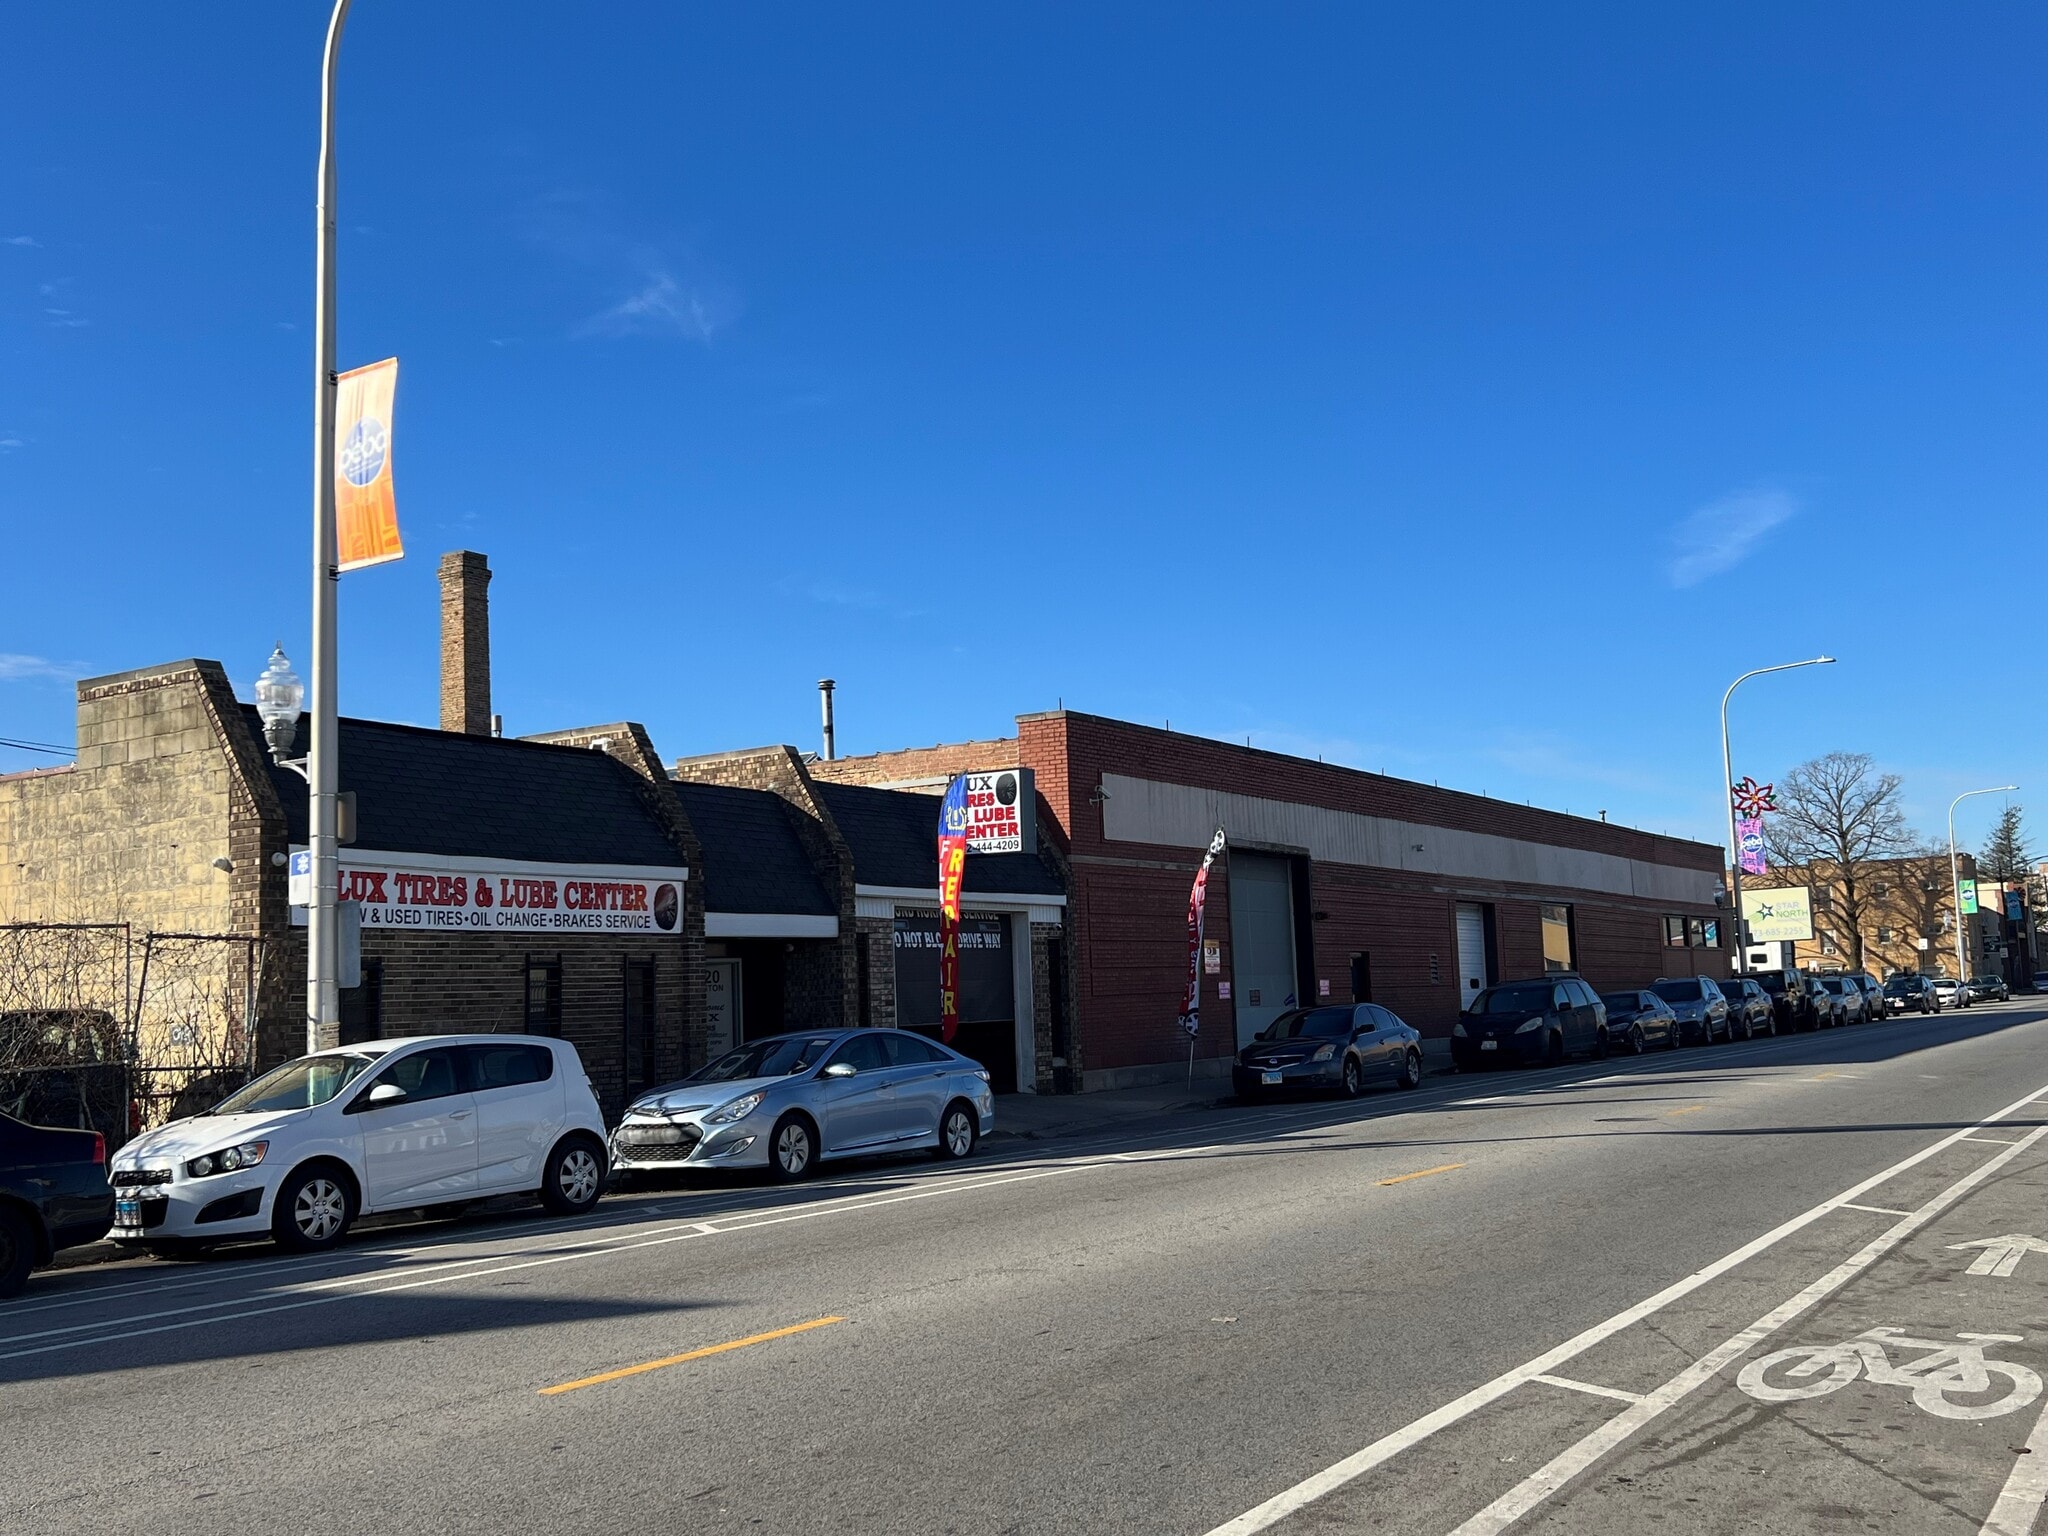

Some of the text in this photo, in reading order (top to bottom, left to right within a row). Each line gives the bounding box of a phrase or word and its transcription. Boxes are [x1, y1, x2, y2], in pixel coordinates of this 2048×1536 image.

[967, 775, 993, 792] UX
[967, 792, 995, 808] RES
[974, 806, 1016, 823] LUBE
[966, 822, 1019, 839] ENTER
[966, 840, 1020, 853] 2-444-4209
[337, 870, 649, 912] LUX TIRES & LUBE CENTER
[371, 907, 381, 923] &
[385, 908, 422, 924] USED
[606, 915, 651, 929] SERVICE
[1775, 909, 1808, 919] NORTH
[904, 932, 922, 947] NOT
